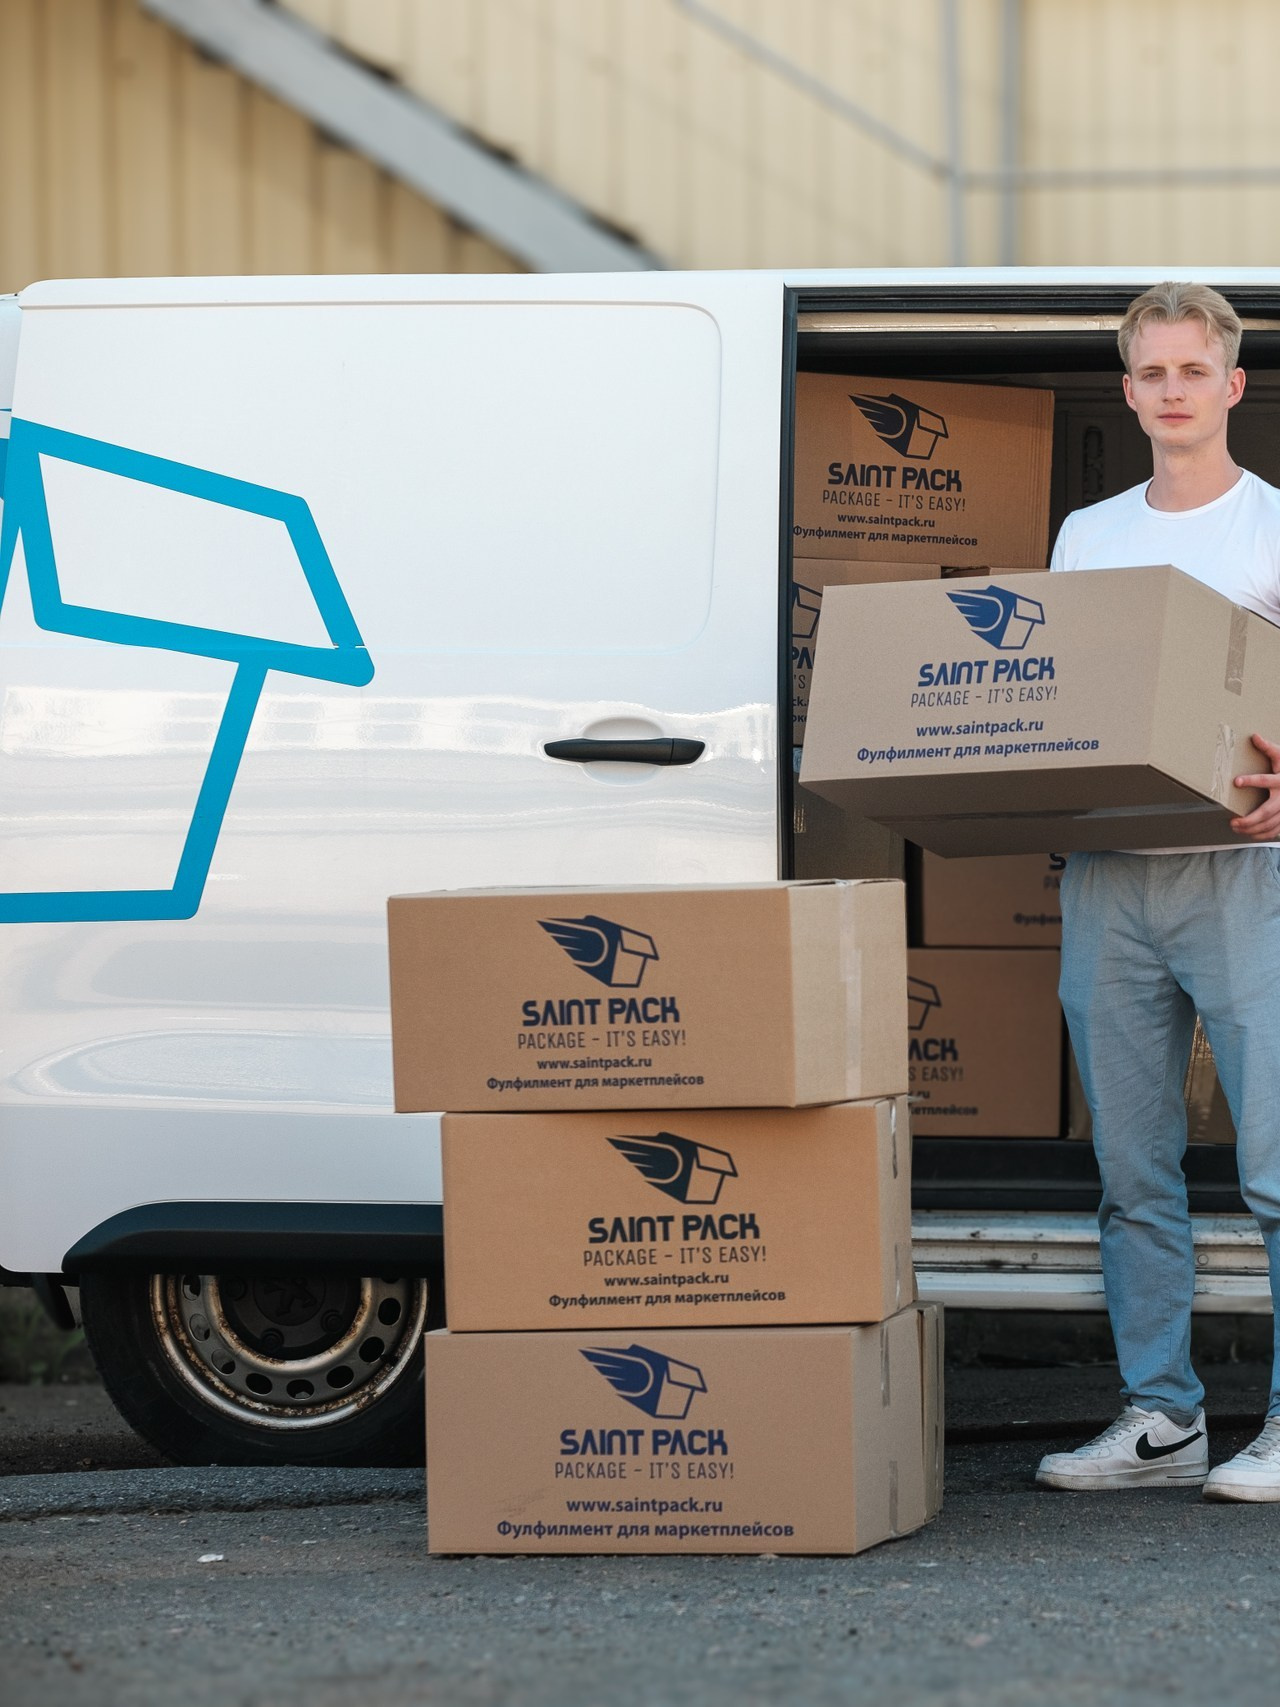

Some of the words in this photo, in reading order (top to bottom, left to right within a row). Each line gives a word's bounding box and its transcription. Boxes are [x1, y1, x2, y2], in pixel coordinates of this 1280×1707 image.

[828, 462, 897, 488] SAINT
[902, 466, 962, 492] PACK
[822, 489, 881, 507] PACKAGE
[898, 494, 923, 509] IT'S
[929, 496, 966, 512] EASY!
[837, 513, 935, 528] www.saintpack.ru
[793, 525, 866, 540] Фулфилмент
[868, 532, 889, 542] для
[891, 532, 978, 546] маркетплейсов
[917, 660, 989, 687] SAINT
[993, 656, 1055, 683] PACK
[910, 690, 970, 708] PACKAGE
[988, 688, 1014, 704] IT'S
[1019, 686, 1058, 702] EASY!
[916, 718, 1044, 737] www.saintpack.ru
[857, 746, 950, 764] Фулфилмент
[954, 744, 981, 759] для
[984, 738, 1099, 757] маркетплейсов
[522, 998, 601, 1026] SAINT
[608, 996, 680, 1024] PACK
[518, 1032, 586, 1049] PACKAGE
[606, 1030, 636, 1047] IT'S
[642, 1029, 686, 1046] EASY!
[908, 1038, 958, 1061] ACK
[537, 1056, 652, 1071] www.saintpack.ru
[487, 1077, 571, 1092] Фулфилмент
[574, 1078, 599, 1090] для
[601, 1074, 705, 1089] маркетплейсов
[588, 1215, 674, 1243] SAINT
[682, 1213, 760, 1241] PACK
[583, 1249, 657, 1267] PACKAGE
[680, 1247, 712, 1264] IT'S
[719, 1245, 767, 1263] EASY!
[604, 1272, 729, 1288] www.saintpack.ru
[549, 1294, 642, 1310] Фулфилмент
[645, 1295, 672, 1308] для
[674, 1290, 786, 1306] маркетплейсов
[560, 1429, 644, 1455] SAINT
[652, 1429, 728, 1455] PACK
[555, 1462, 627, 1479] PACKAGE
[649, 1462, 681, 1479] IT'S
[688, 1461, 735, 1479] EASY!
[566, 1497, 723, 1515] www.saintpack.ru
[497, 1521, 613, 1539] Фулфилмент
[617, 1524, 650, 1538] для
[654, 1522, 795, 1540] маркетплейсов
